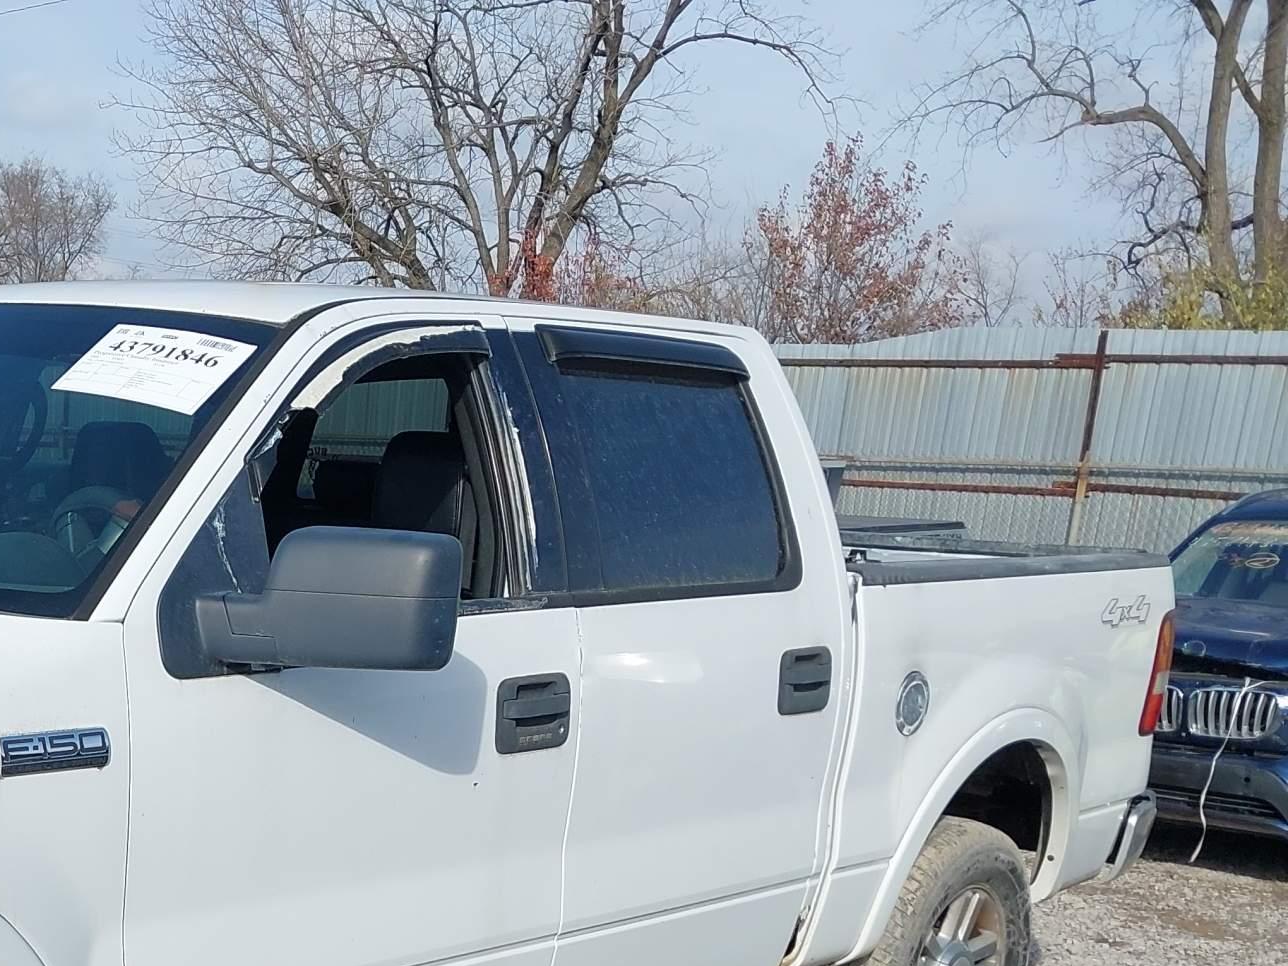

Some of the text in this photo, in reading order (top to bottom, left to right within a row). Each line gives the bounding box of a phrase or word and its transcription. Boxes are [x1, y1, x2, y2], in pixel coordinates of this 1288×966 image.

[108, 339, 225, 368] 43791846
[1101, 594, 1151, 629] 4x4
[0, 730, 108, 763] F-150
